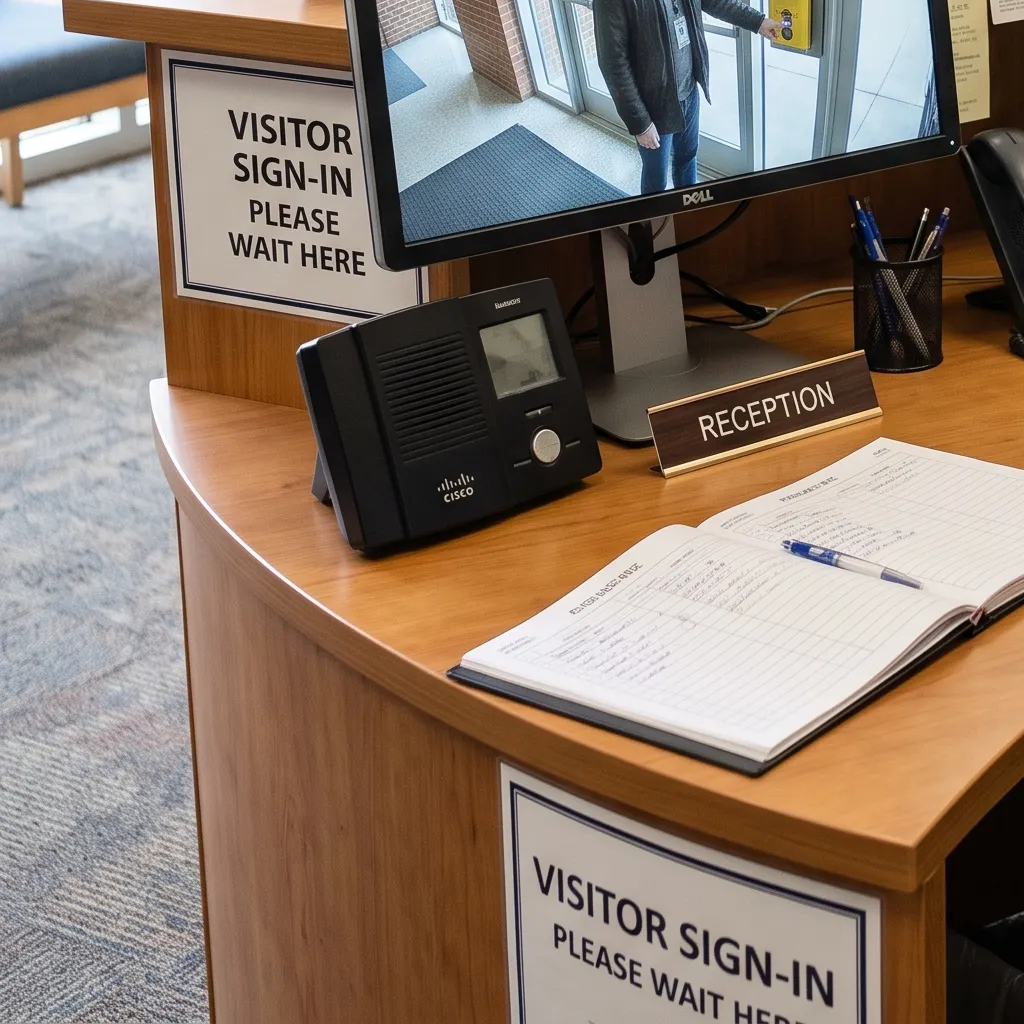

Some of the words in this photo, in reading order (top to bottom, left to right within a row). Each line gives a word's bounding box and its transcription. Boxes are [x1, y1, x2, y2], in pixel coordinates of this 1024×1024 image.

[227, 109, 353, 155] VISITOR
[233, 152, 353, 198] SIGN-IN
[682, 189, 714, 206] DELL
[249, 199, 340, 236] PLEASE
[228, 231, 293, 264] WAIT
[300, 242, 366, 276] HERE
[698, 380, 835, 442] RECEPTION
[532, 855, 668, 951] VISITOR
[679, 922, 834, 1008] SIGN-IN
[553, 922, 643, 989] PLEASE
[650, 967, 724, 1020] WAIT
